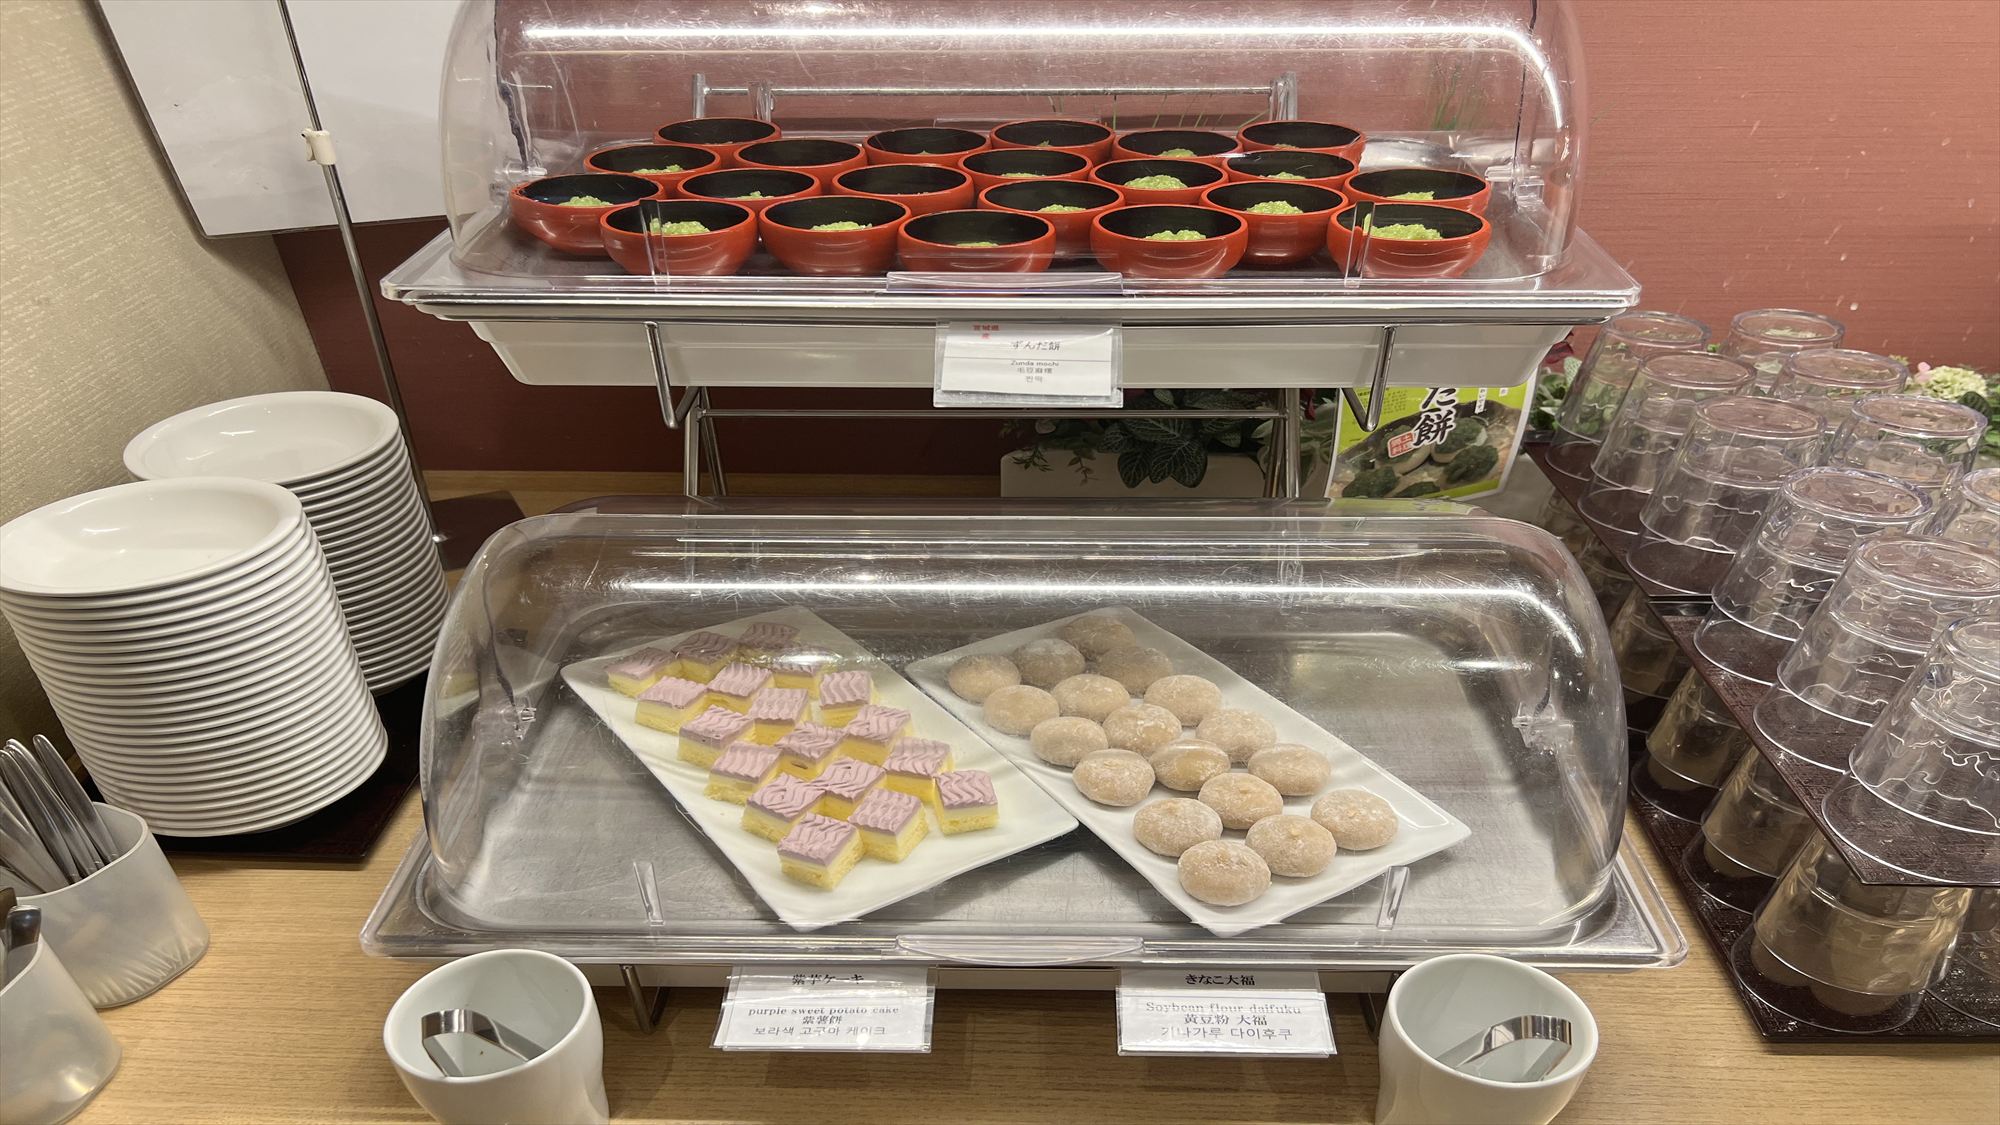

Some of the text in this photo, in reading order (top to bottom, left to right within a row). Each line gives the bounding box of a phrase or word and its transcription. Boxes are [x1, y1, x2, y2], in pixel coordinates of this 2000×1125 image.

[1011, 340, 1060, 351] ずんだ餅
[792, 973, 864, 985] 紫芋ケーキ
[1185, 974, 1256, 986] きなこ大福
[748, 1006, 899, 1016] purple sweet potato cake
[1146, 1001, 1302, 1015] Soybean flour daifuku
[1237, 1014, 1268, 1026] 大福
[753, 1026, 886, 1037] 보라색 고구마 케이크
[1230, 1027, 1293, 1040] 다이후쿠
